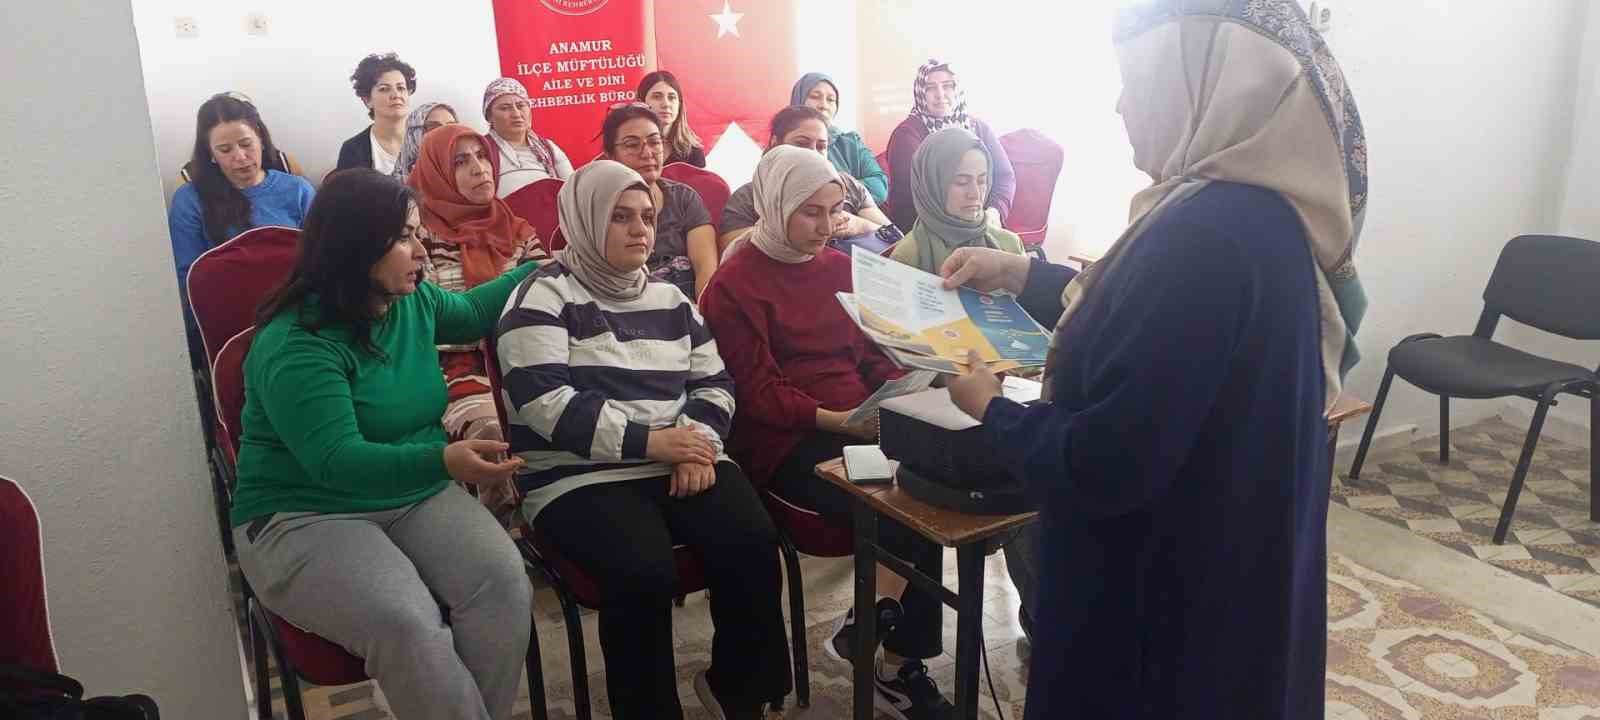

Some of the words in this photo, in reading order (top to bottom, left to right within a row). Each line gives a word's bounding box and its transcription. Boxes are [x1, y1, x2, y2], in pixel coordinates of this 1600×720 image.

[550, 40, 612, 55] ANAMUR
[518, 62, 552, 77] İLÇE
[557, 54, 646, 73] MÜFTÜLÜĞÜ
[543, 78, 573, 91] AİLE
[577, 77, 594, 88] VE
[599, 73, 625, 87] DİNİ
[529, 93, 596, 109] EHBERLİK
[600, 90, 636, 103] BÜRO
